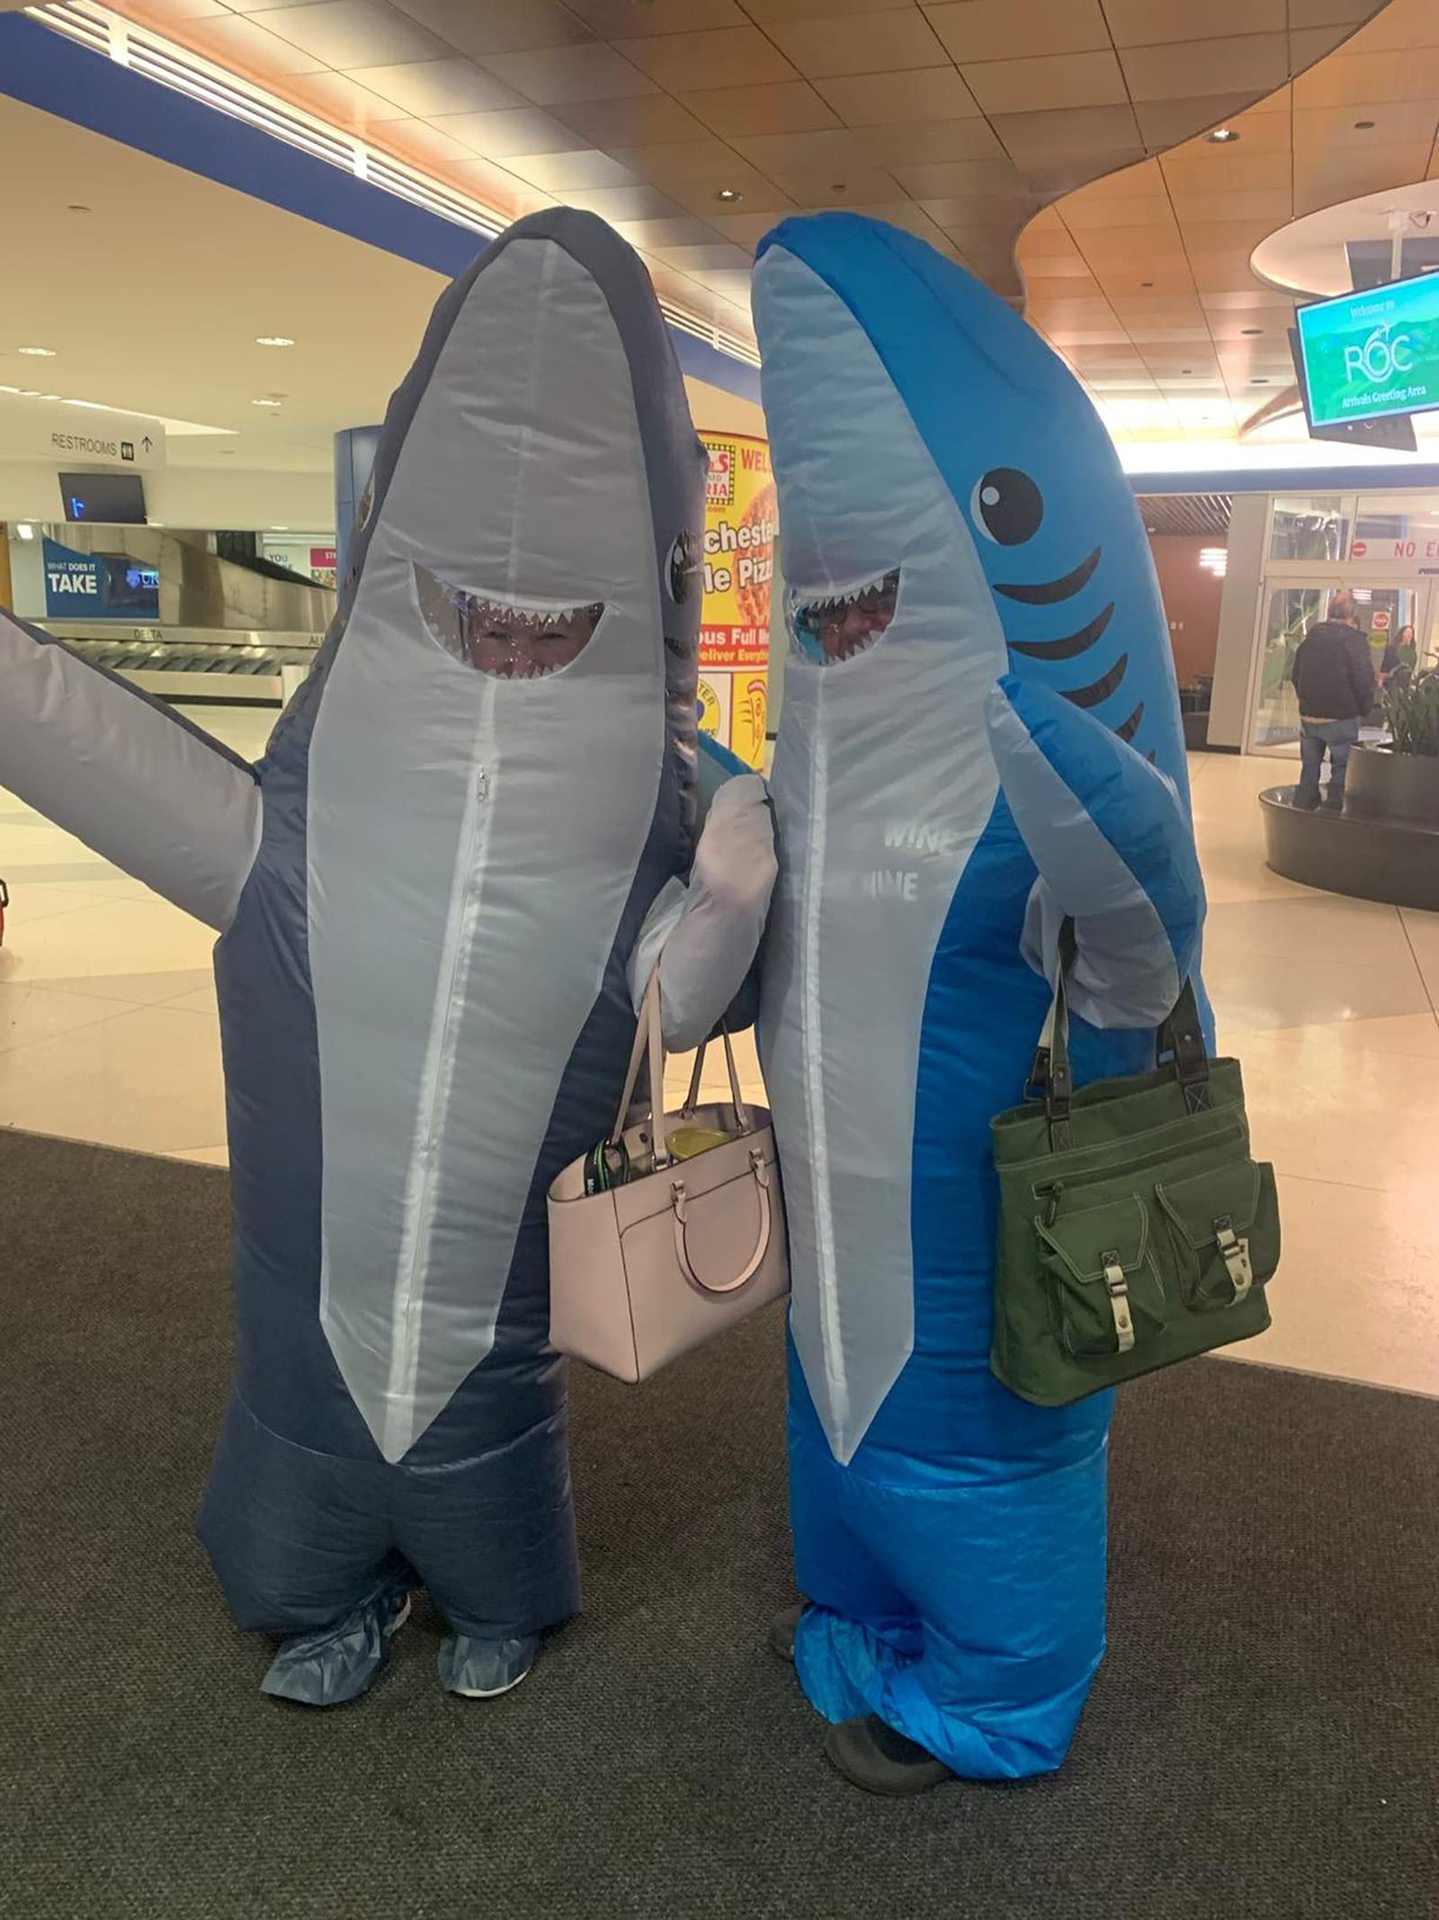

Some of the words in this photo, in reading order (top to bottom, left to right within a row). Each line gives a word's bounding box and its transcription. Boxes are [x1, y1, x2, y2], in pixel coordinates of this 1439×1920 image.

[1344, 335, 1413, 383] ROC
[1342, 393, 1371, 409] Arrivals
[1372, 388, 1407, 404] Greeting
[1407, 385, 1427, 396] Area
[51, 433, 117, 456] RESTROOMS
[741, 448, 771, 473] WEL
[1394, 542, 1416, 558] NO
[1426, 542, 1439, 558] E
[47, 562, 68, 571] WHAT
[68, 563, 88, 572] DOES
[88, 563, 96, 572] IT
[48, 573, 97, 594] TAKE
[134, 629, 162, 640] DELTA
[731, 627, 757, 645] Full
[699, 648, 736, 662] eliver
